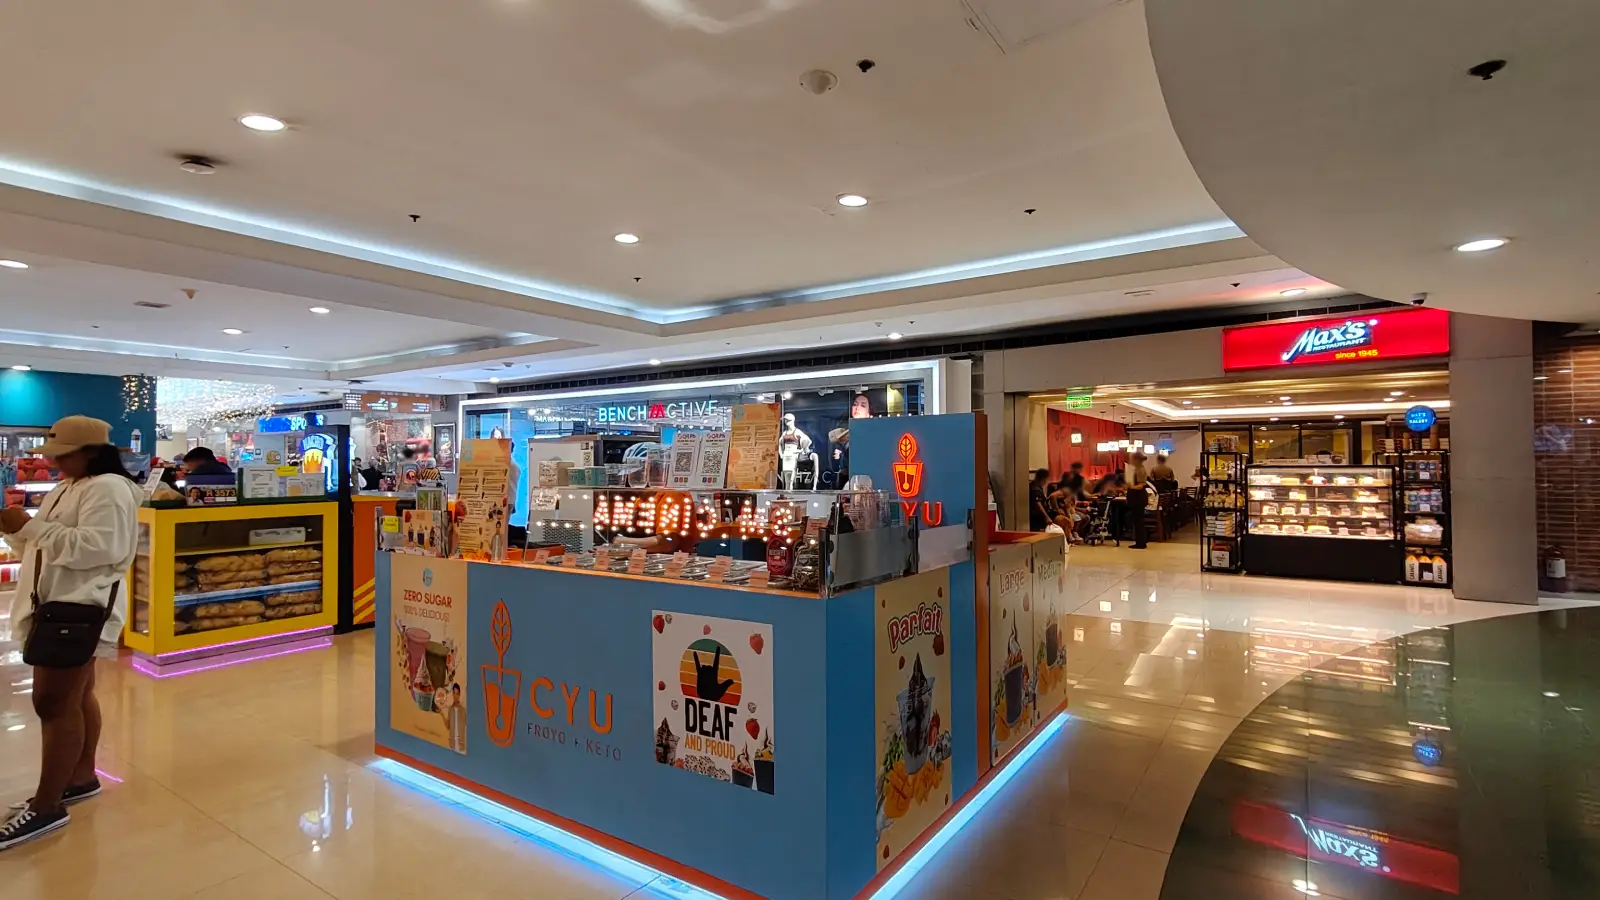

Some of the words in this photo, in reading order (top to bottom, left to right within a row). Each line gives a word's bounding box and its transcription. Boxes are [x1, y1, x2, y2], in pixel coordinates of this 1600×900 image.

[1282, 320, 1367, 361] Max's
[1312, 337, 1366, 351] RESTAURANT
[1335, 351, 1356, 359] since
[1358, 349, 1378, 357] 1945
[598, 405, 647, 422] BENCH
[1000, 570, 1025, 597] Large
[404, 589, 422, 602] ZERO
[424, 592, 452, 608] SUGAR
[530, 676, 613, 734] CYU
[684, 697, 738, 742] DEAF
[527, 722, 567, 745] FROYO
[586, 739, 622, 761] KETO
[684, 733, 702, 752] AND
[705, 738, 736, 761] PROUD
